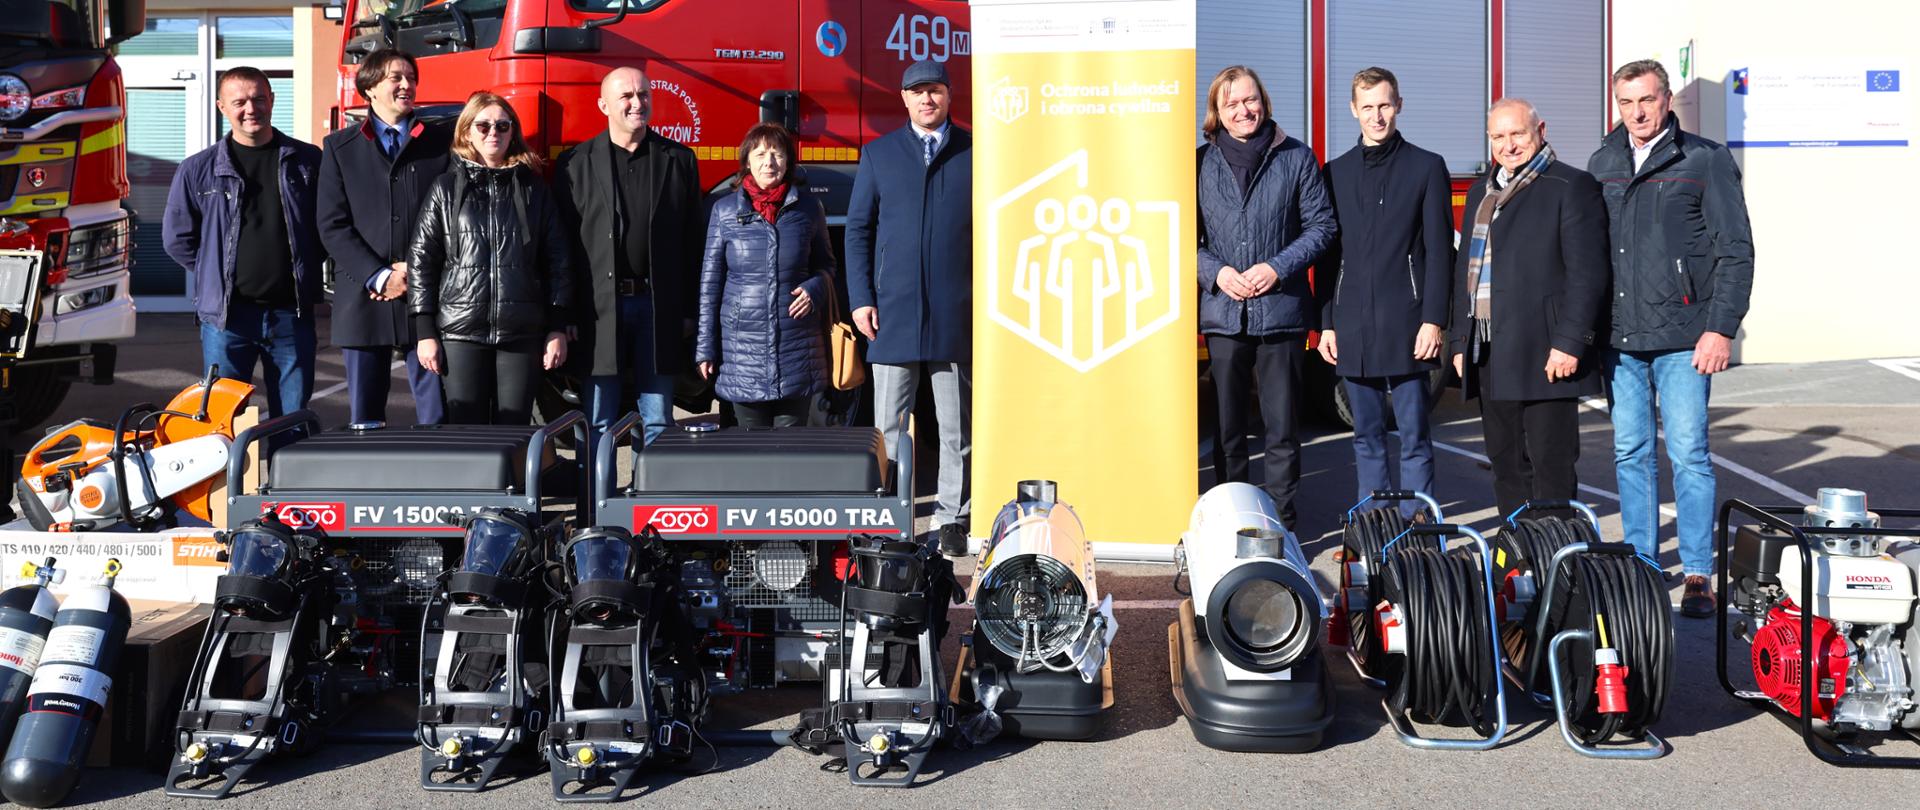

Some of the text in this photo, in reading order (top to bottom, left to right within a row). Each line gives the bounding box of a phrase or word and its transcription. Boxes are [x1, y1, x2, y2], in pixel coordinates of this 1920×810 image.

[886, 13, 950, 63] 469
[743, 49, 784, 59] 13.290
[1040, 79, 1180, 98] Ochrona ludności
[650, 79, 701, 142] STRAŻ POŻARNA
[1040, 98, 1171, 118] i obrona cywilna
[354, 506, 384, 524] FV
[726, 508, 895, 526] FV 15000 TRA
[2, 543, 18, 555] TS
[21, 544, 41, 555] 410
[49, 544, 68, 555] 420
[76, 544, 96, 555] 440
[103, 544, 123, 556] 480
[137, 545, 156, 556] 500
[1846, 575, 1892, 583] HONDA
[70, 676, 83, 684] 300
[44, 699, 81, 711] Honeywell
